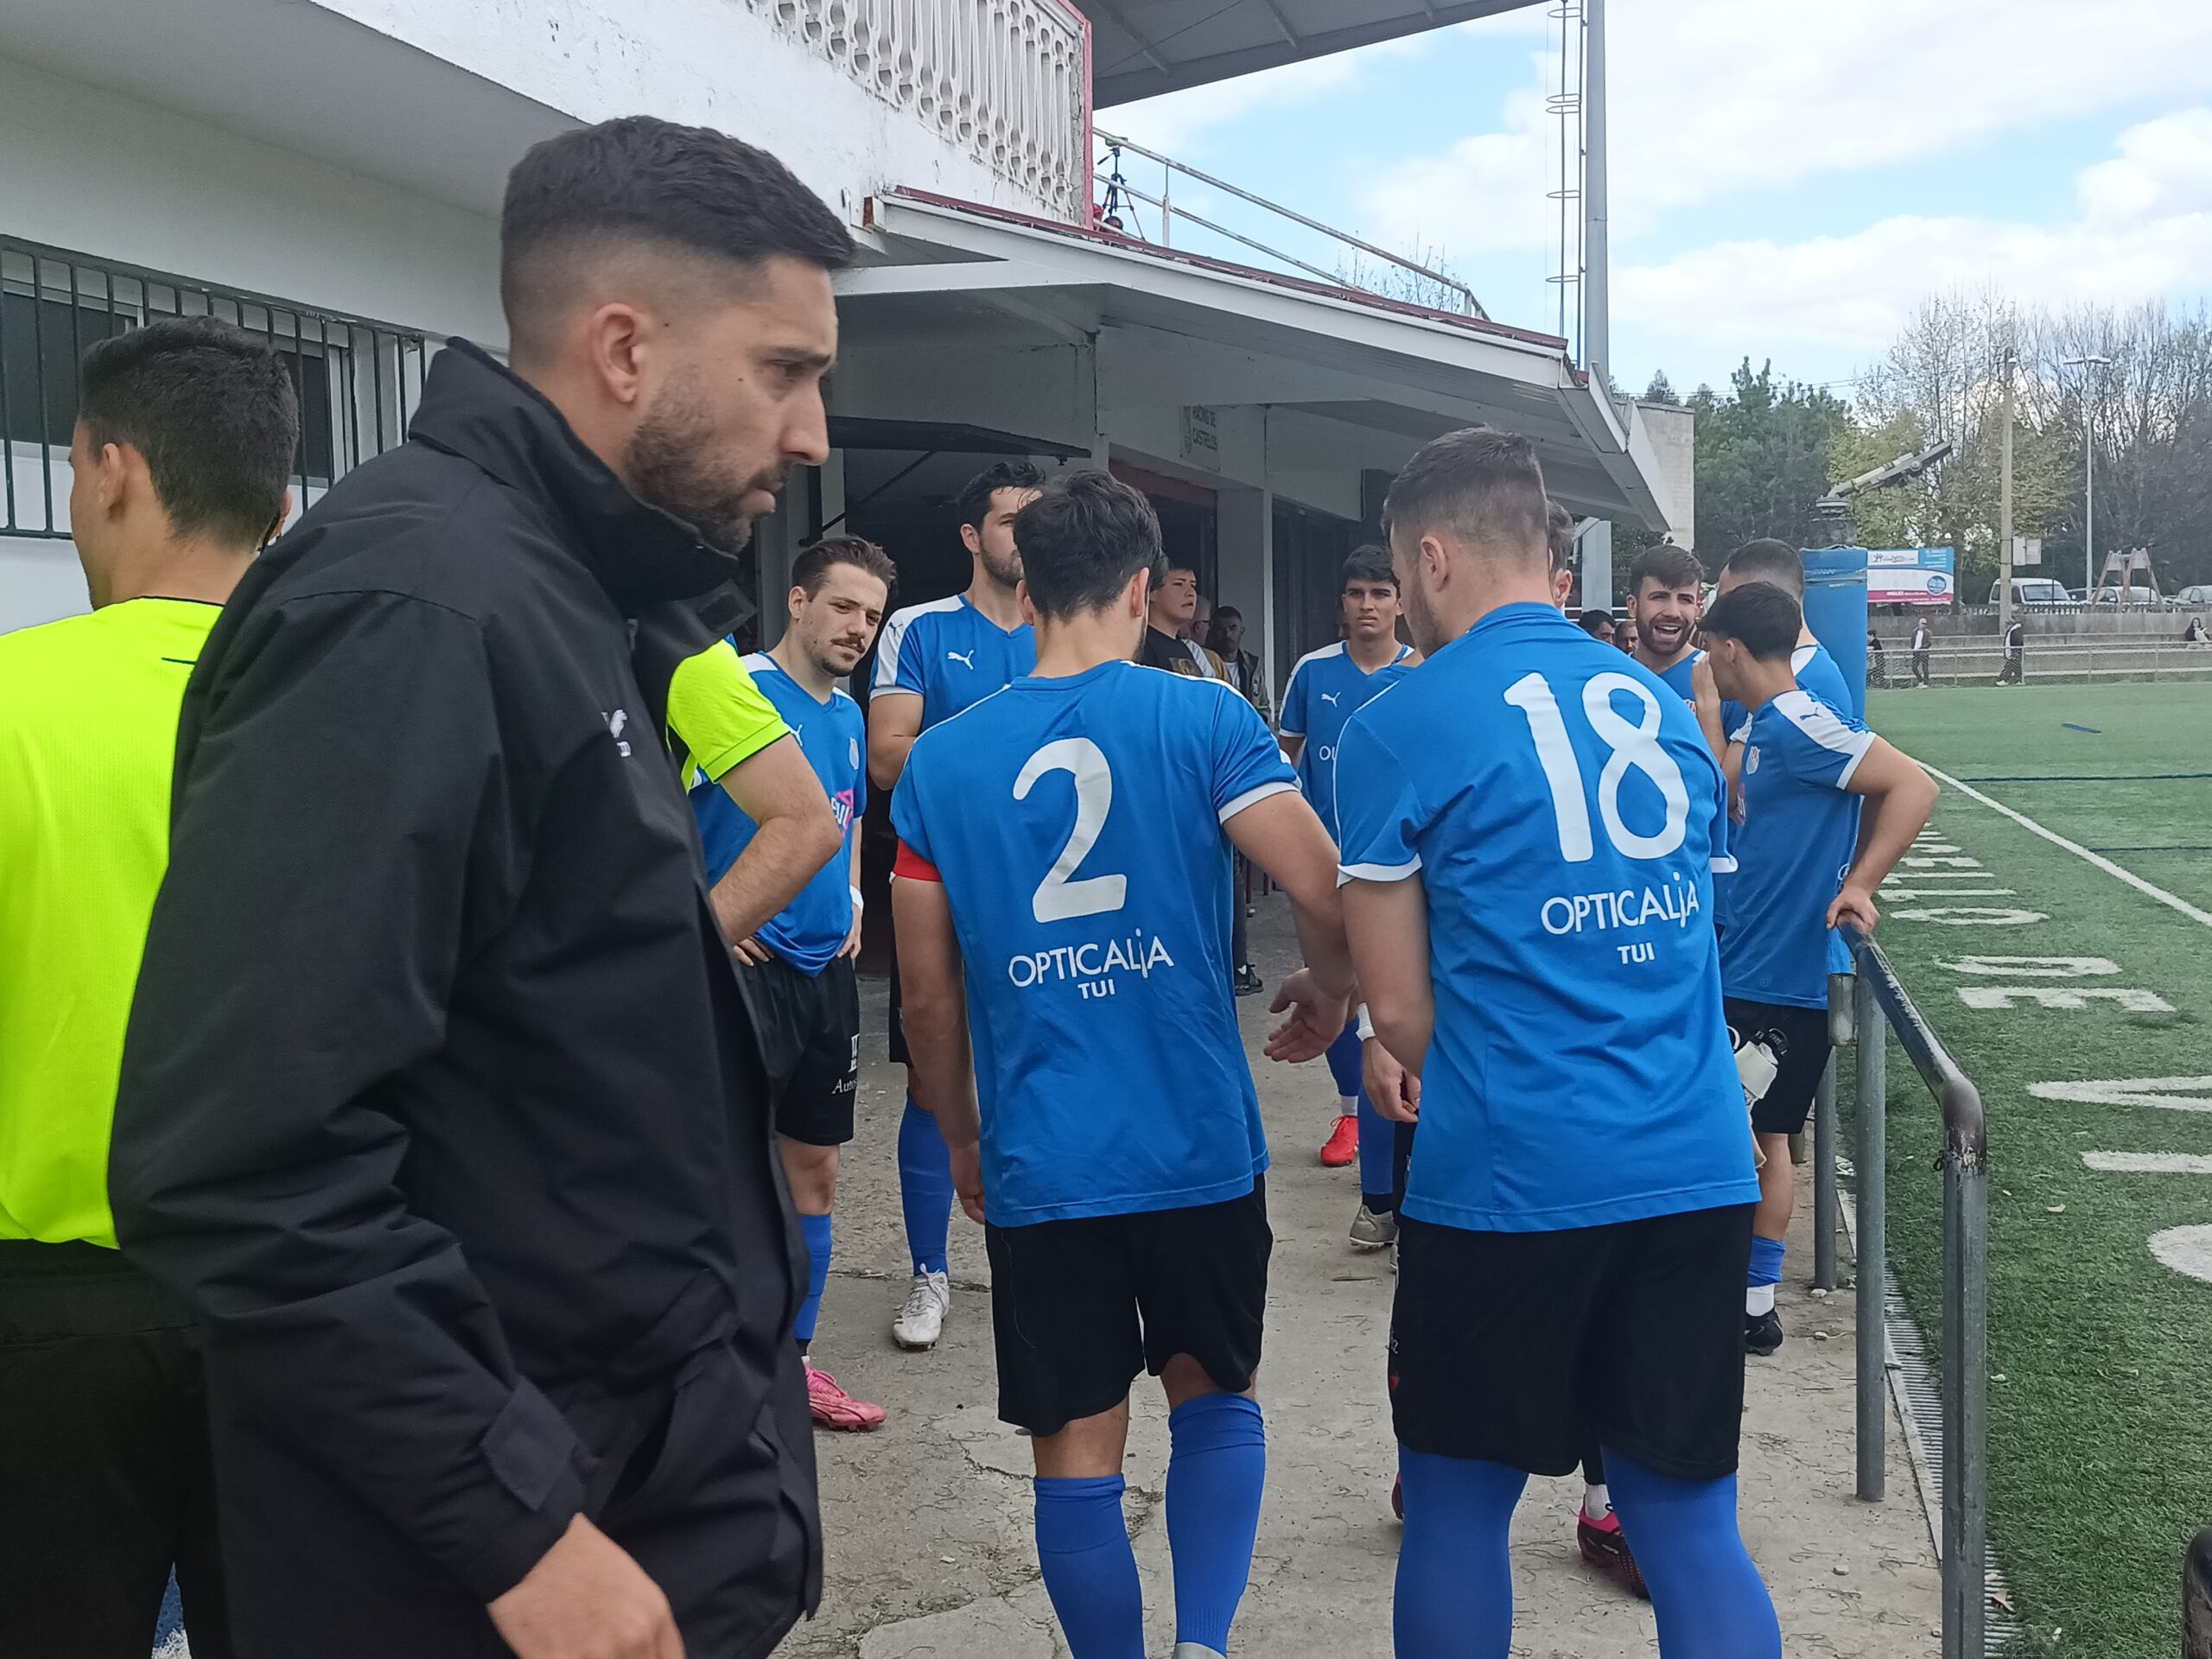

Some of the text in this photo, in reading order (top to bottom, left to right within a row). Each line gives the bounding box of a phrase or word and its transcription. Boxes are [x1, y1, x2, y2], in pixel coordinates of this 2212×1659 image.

[1503, 671, 1690, 862] 18
[1013, 737, 1127, 923] 2
[1077, 978, 1116, 1000] TUI
[1617, 942, 1656, 965] TUI
